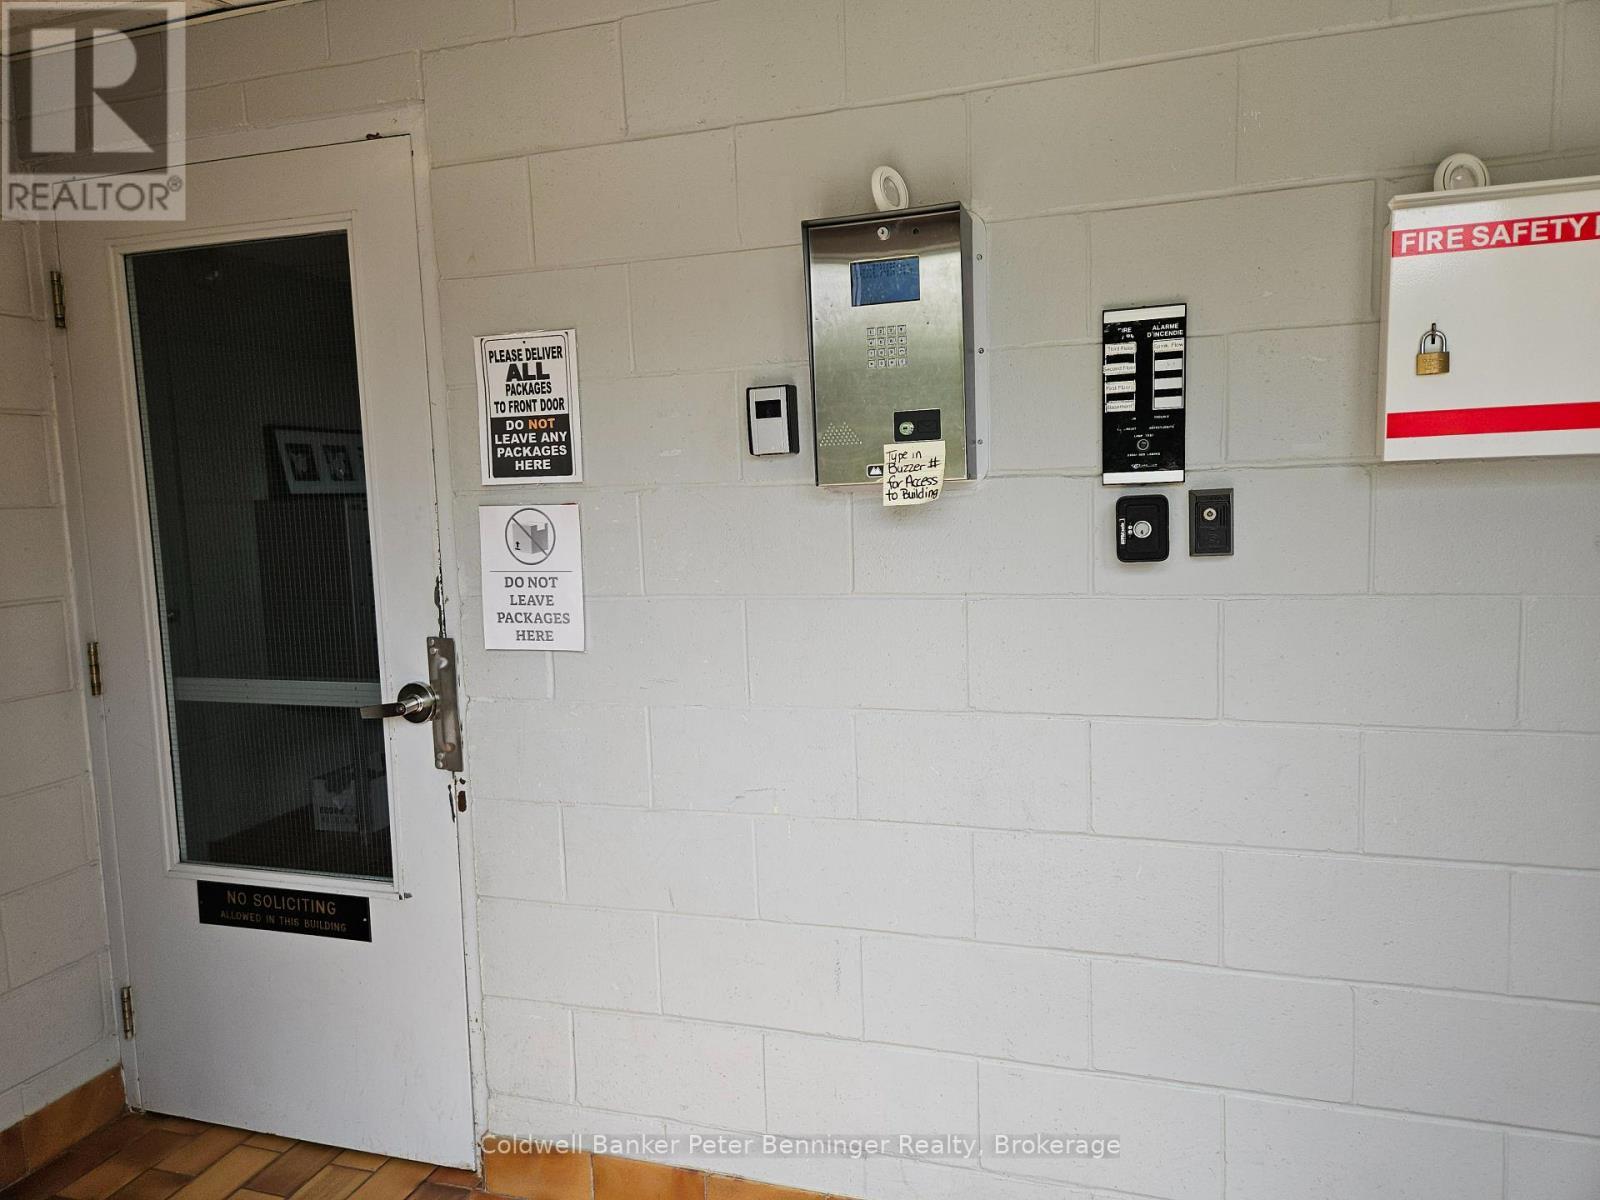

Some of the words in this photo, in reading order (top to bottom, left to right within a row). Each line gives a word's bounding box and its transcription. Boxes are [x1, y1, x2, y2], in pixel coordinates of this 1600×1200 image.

[1401, 227, 1464, 254] FIRE
[1472, 215, 1589, 247] SAFETY
[1147, 330, 1184, 338] D'INCENDIE
[489, 348, 523, 363] PLEASE
[525, 346, 563, 361] DELIVER
[506, 362, 550, 382] ALL
[505, 382, 552, 396] PACKAGES
[494, 401, 506, 414] TO
[509, 399, 538, 413] FRONT
[540, 397, 565, 411] DOOR
[506, 420, 524, 431] DO
[528, 418, 556, 430] NOT
[495, 433, 536, 445] LEAVE
[541, 431, 567, 443] ANY
[497, 445, 567, 458] PACKAGES
[886, 449, 908, 463] Type
[912, 451, 922, 459] in
[515, 459, 551, 471] HERE
[888, 462, 926, 475] Buzzer
[927, 456, 942, 468] #
[886, 475, 903, 489] for
[905, 474, 938, 488] Access
[885, 488, 898, 501] to
[900, 487, 939, 499] Building
[504, 577, 524, 588] DO
[528, 577, 558, 588] NOT
[510, 594, 555, 606] LEAVE
[497, 612, 570, 624] PACKAGES
[516, 630, 554, 641] HERE
[226, 890, 247, 906] NO
[253, 893, 337, 915] SOLICITING
[220, 910, 262, 923] ALLOWED
[265, 914, 275, 924] IN
[279, 915, 300, 927] THIS
[304, 919, 347, 933] BUILDING
